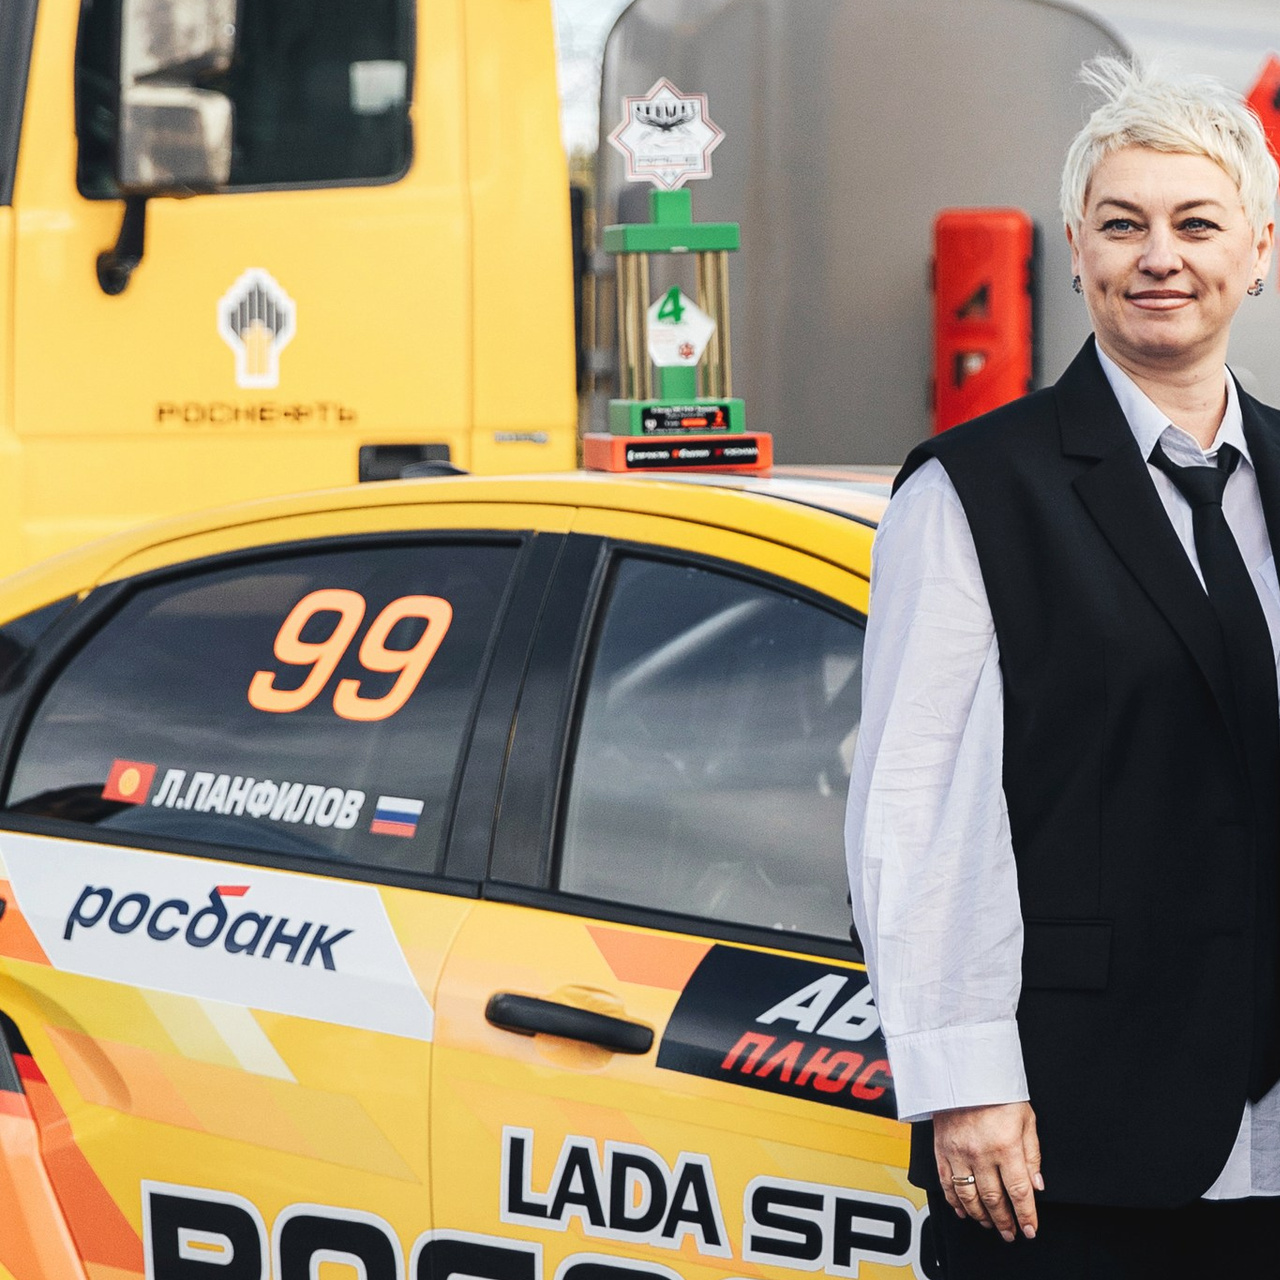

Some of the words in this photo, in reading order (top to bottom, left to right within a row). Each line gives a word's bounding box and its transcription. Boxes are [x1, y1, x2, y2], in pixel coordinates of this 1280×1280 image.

[657, 286, 686, 323] 4
[156, 401, 358, 424] РОСНЕФТЬ
[247, 588, 454, 721] 99
[152, 768, 366, 830] Л.ПАНФИЛОВ
[63, 885, 355, 971] росбанк
[720, 1031, 893, 1100] ПЛЮС
[504, 1131, 727, 1252] LADA
